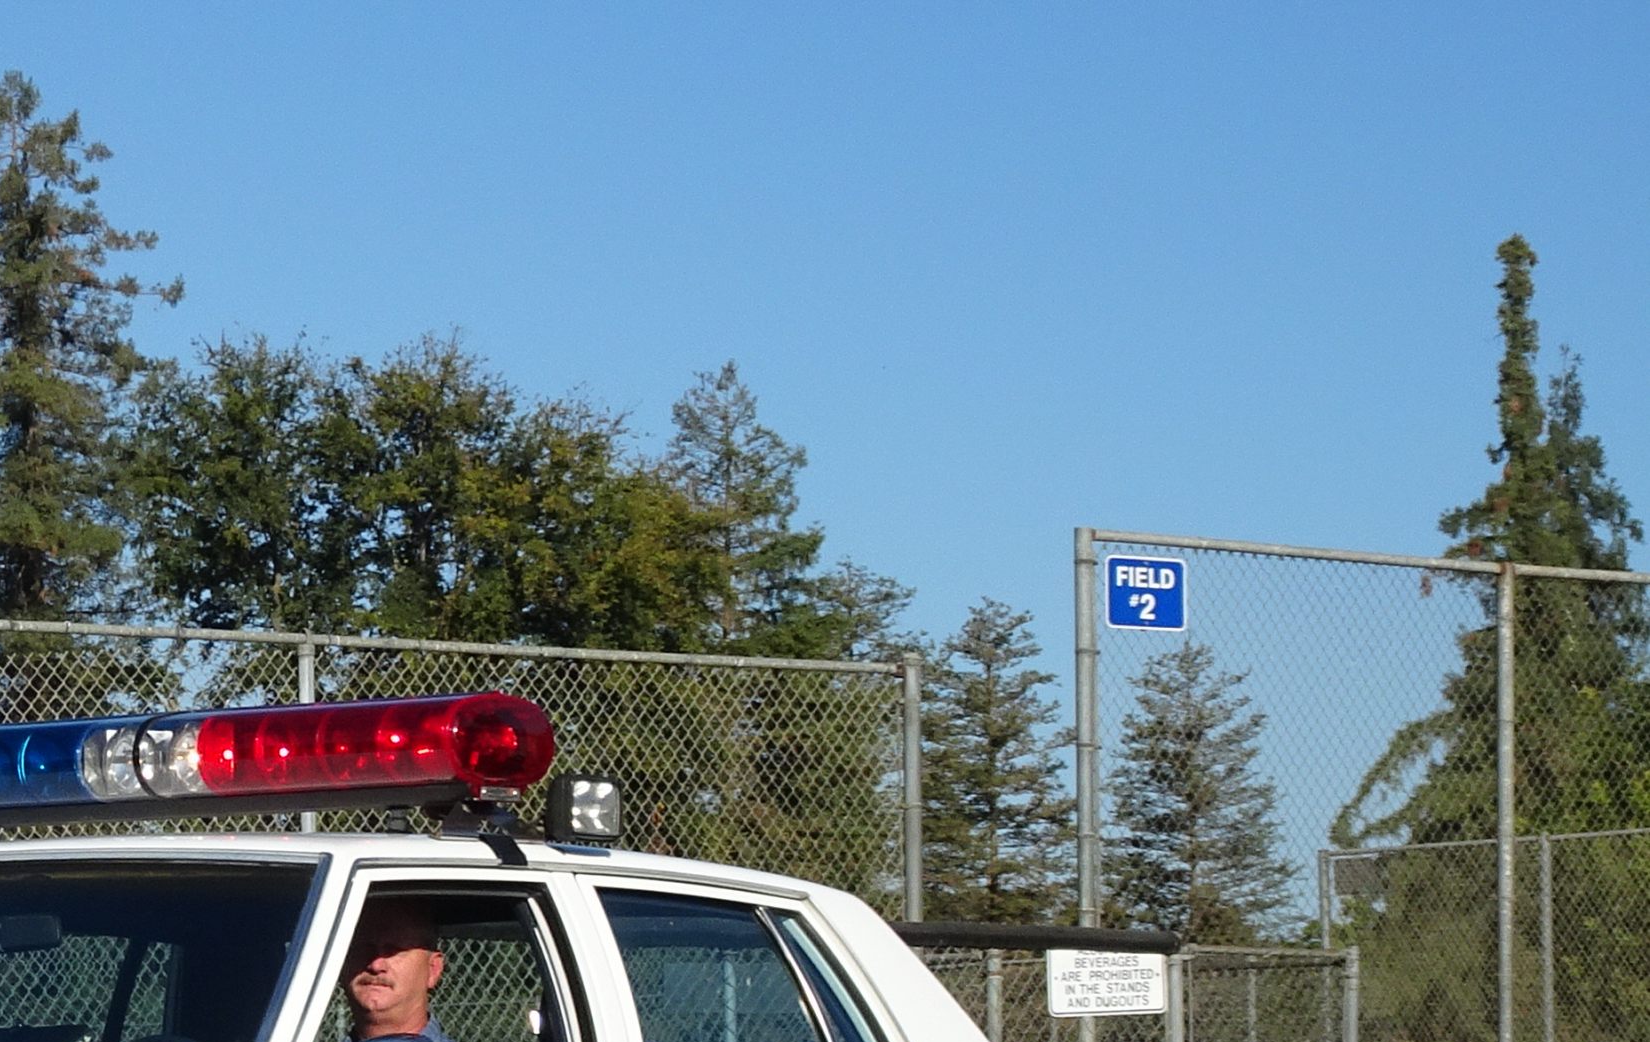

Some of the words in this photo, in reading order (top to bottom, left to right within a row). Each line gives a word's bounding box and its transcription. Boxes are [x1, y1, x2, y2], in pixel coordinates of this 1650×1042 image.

[1116, 565, 1175, 590] FIELD
[1129, 593, 1156, 620] #2
[1074, 955, 1139, 969] BEVERAGES
[1061, 971, 1082, 982] ARE
[1089, 968, 1154, 981] PROHIBITED
[1064, 984, 1076, 995] IN
[1079, 983, 1101, 994] THE
[1106, 981, 1150, 994] STANDS
[1067, 996, 1091, 1008] AND
[1095, 994, 1150, 1007] DUGOUTS
